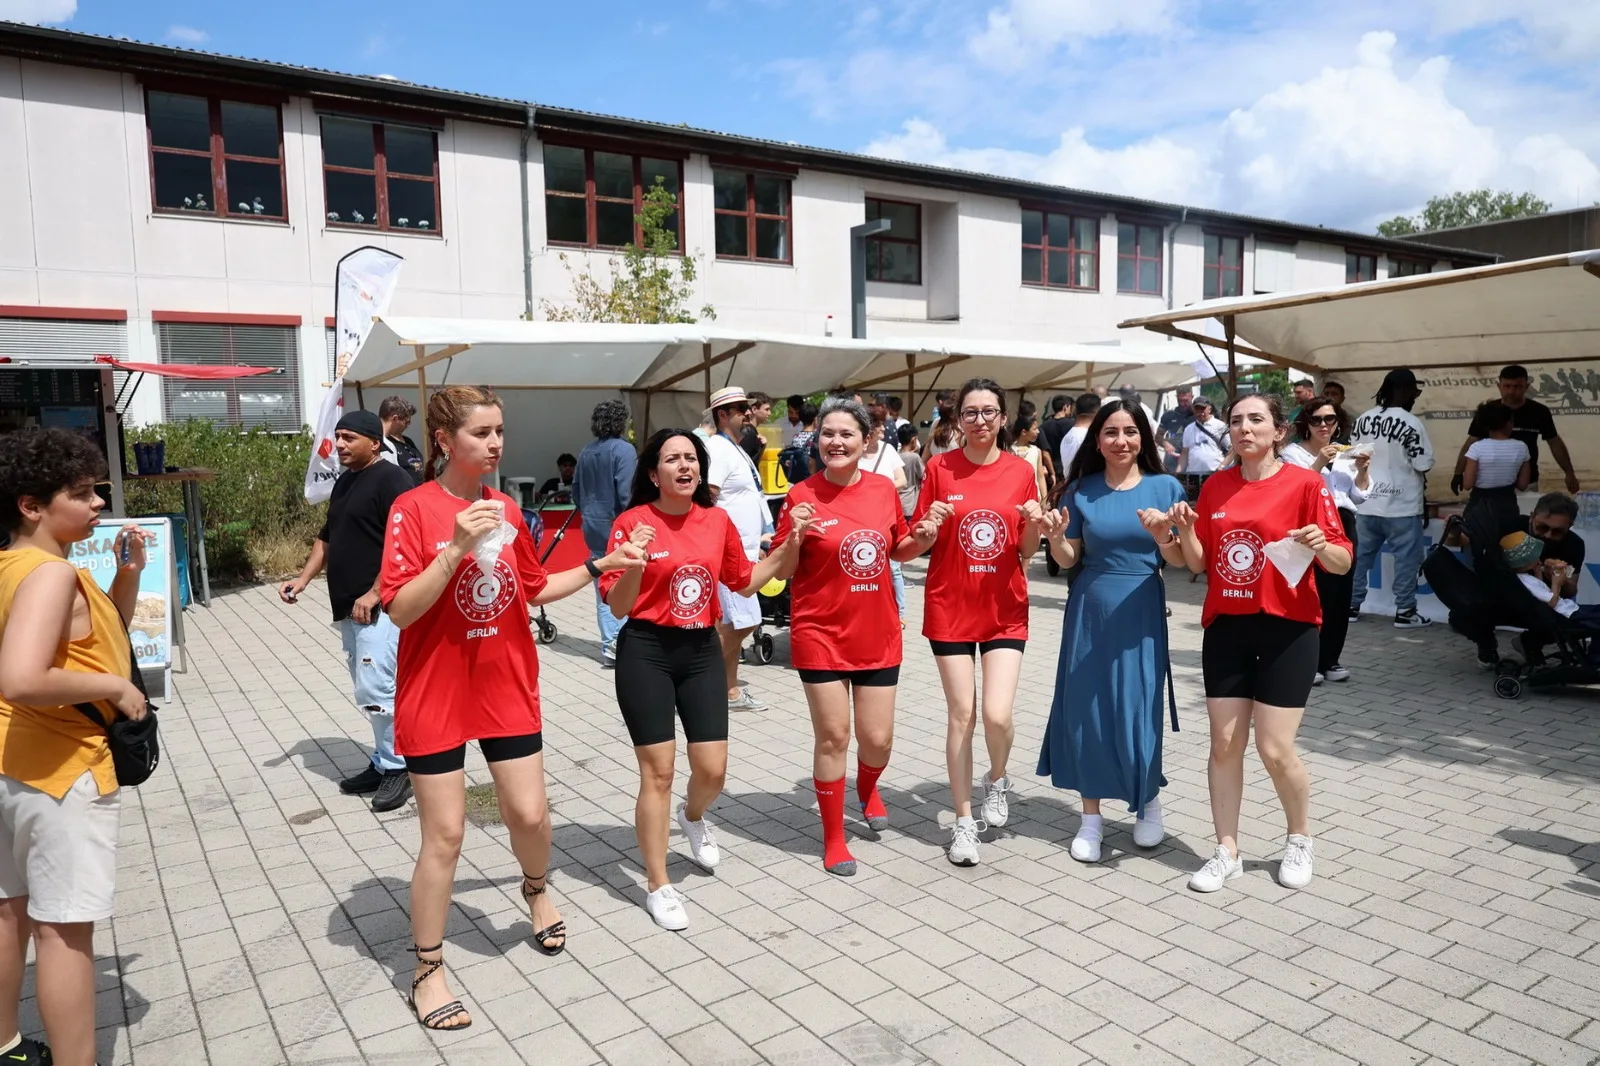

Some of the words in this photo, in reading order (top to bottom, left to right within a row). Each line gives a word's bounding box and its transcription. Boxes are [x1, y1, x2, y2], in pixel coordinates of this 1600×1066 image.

[820, 519, 838, 527] JAKO
[650, 551, 669, 559] JAKO
[969, 564, 996, 573] BERLİN
[850, 583, 879, 592] BERLİN
[1222, 589, 1253, 598] BERLİN
[467, 625, 498, 639] BERLİN
[135, 643, 158, 658] GO!
